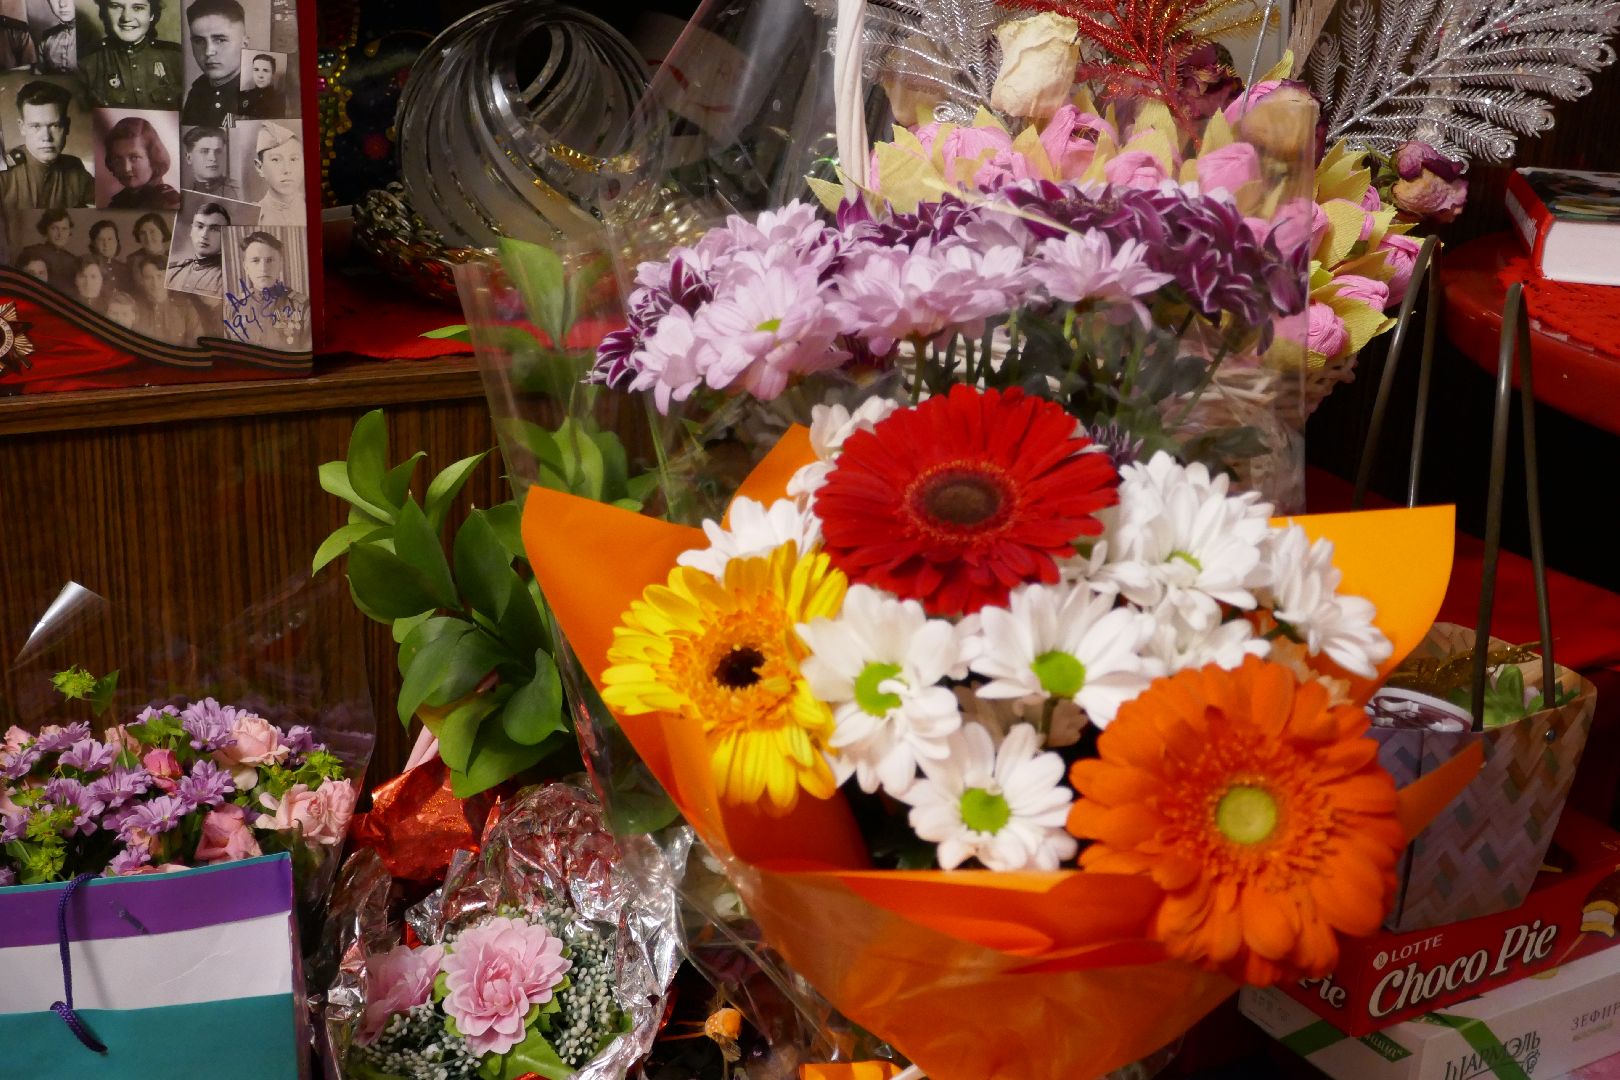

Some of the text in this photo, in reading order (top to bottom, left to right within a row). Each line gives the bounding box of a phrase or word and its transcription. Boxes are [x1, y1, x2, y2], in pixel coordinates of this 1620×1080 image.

[1368, 949, 1488, 1018] Choco
[1489, 919, 1558, 977] Pie
[1390, 933, 1445, 963] LOTTE
